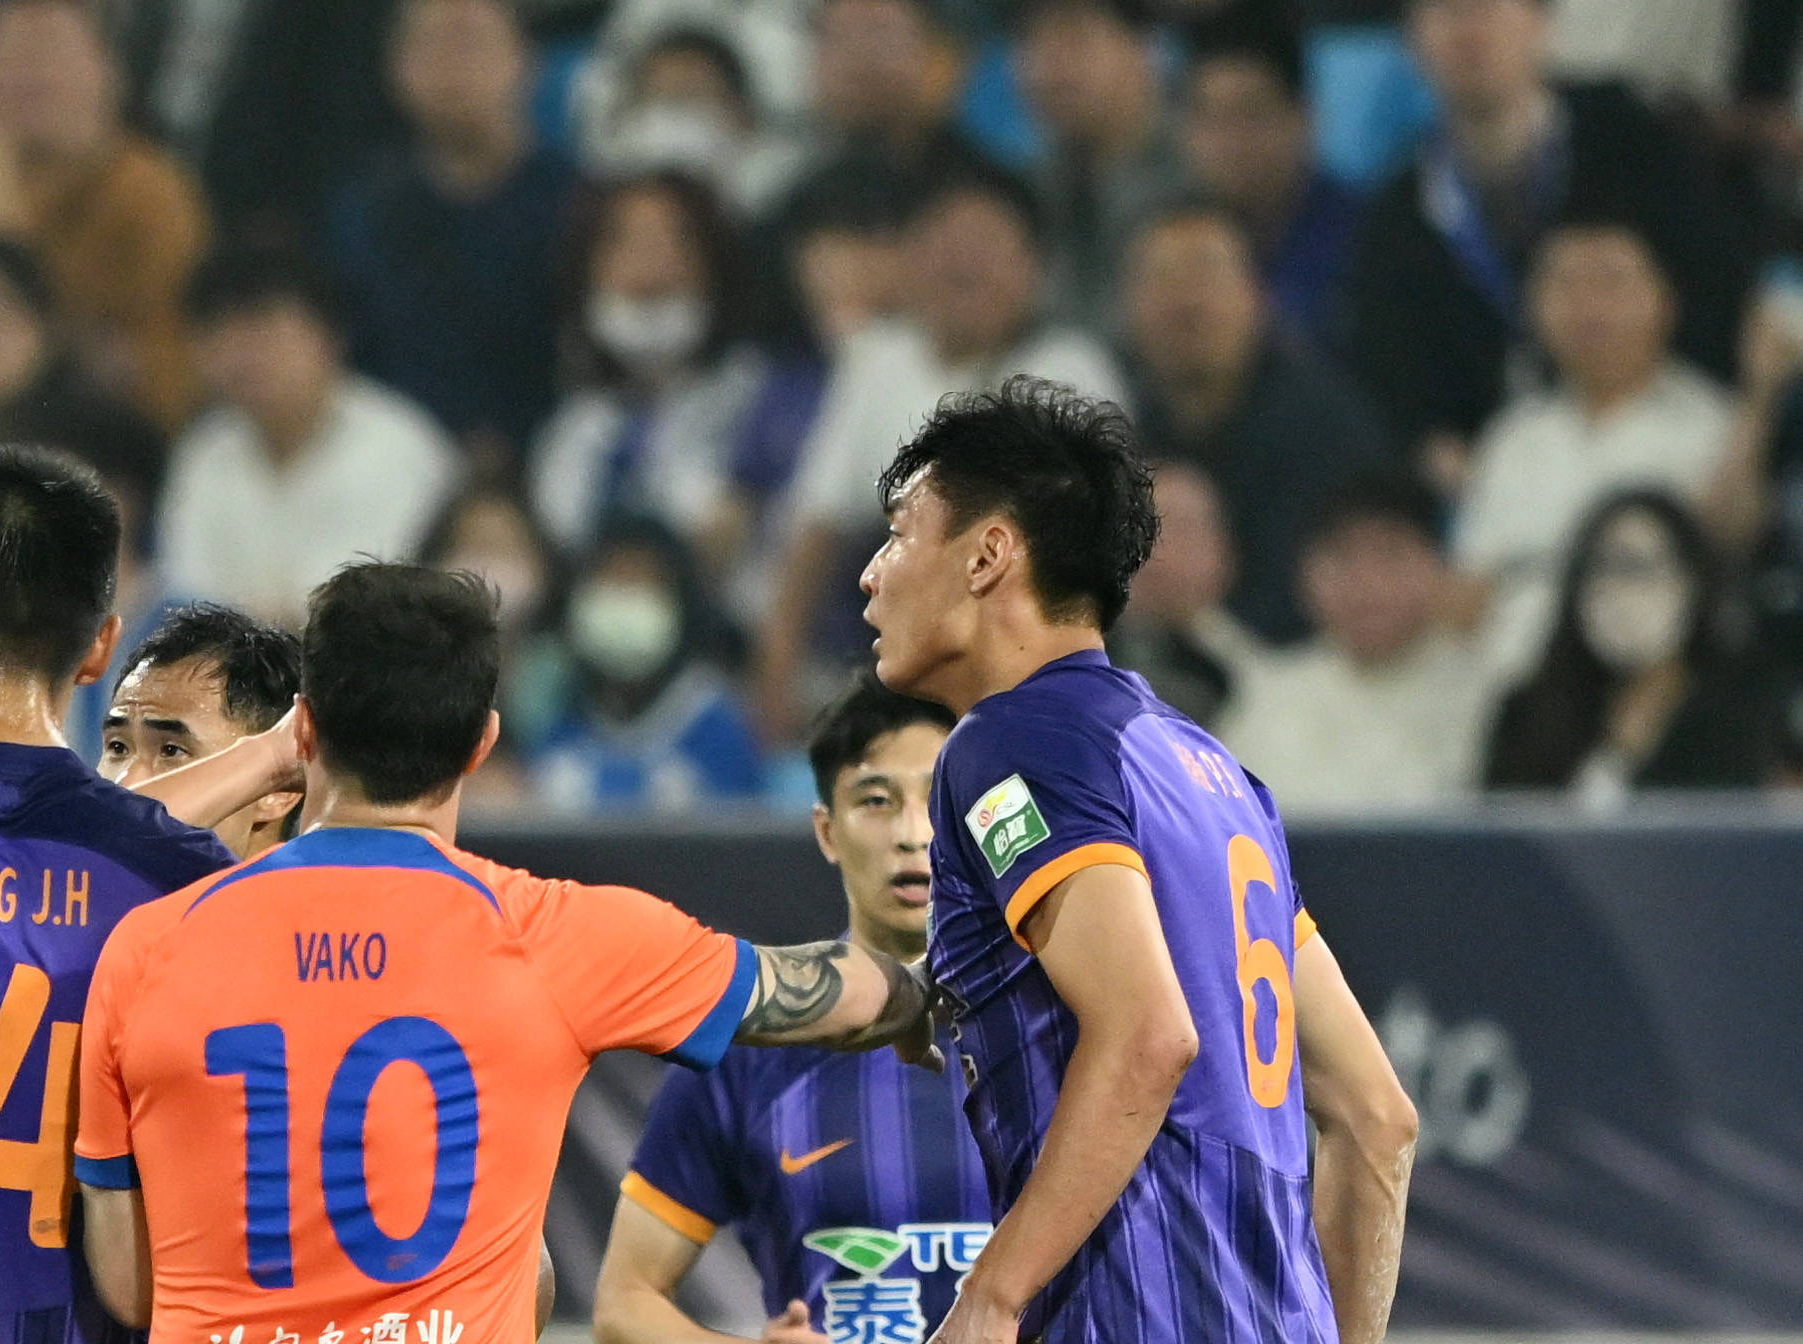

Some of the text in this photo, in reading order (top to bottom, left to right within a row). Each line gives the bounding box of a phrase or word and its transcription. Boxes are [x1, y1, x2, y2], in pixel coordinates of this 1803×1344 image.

[31, 868, 89, 926] J.H
[295, 931, 386, 982] VAKO
[1228, 834, 1295, 1108] 6
[204, 1015, 479, 1289] 10
